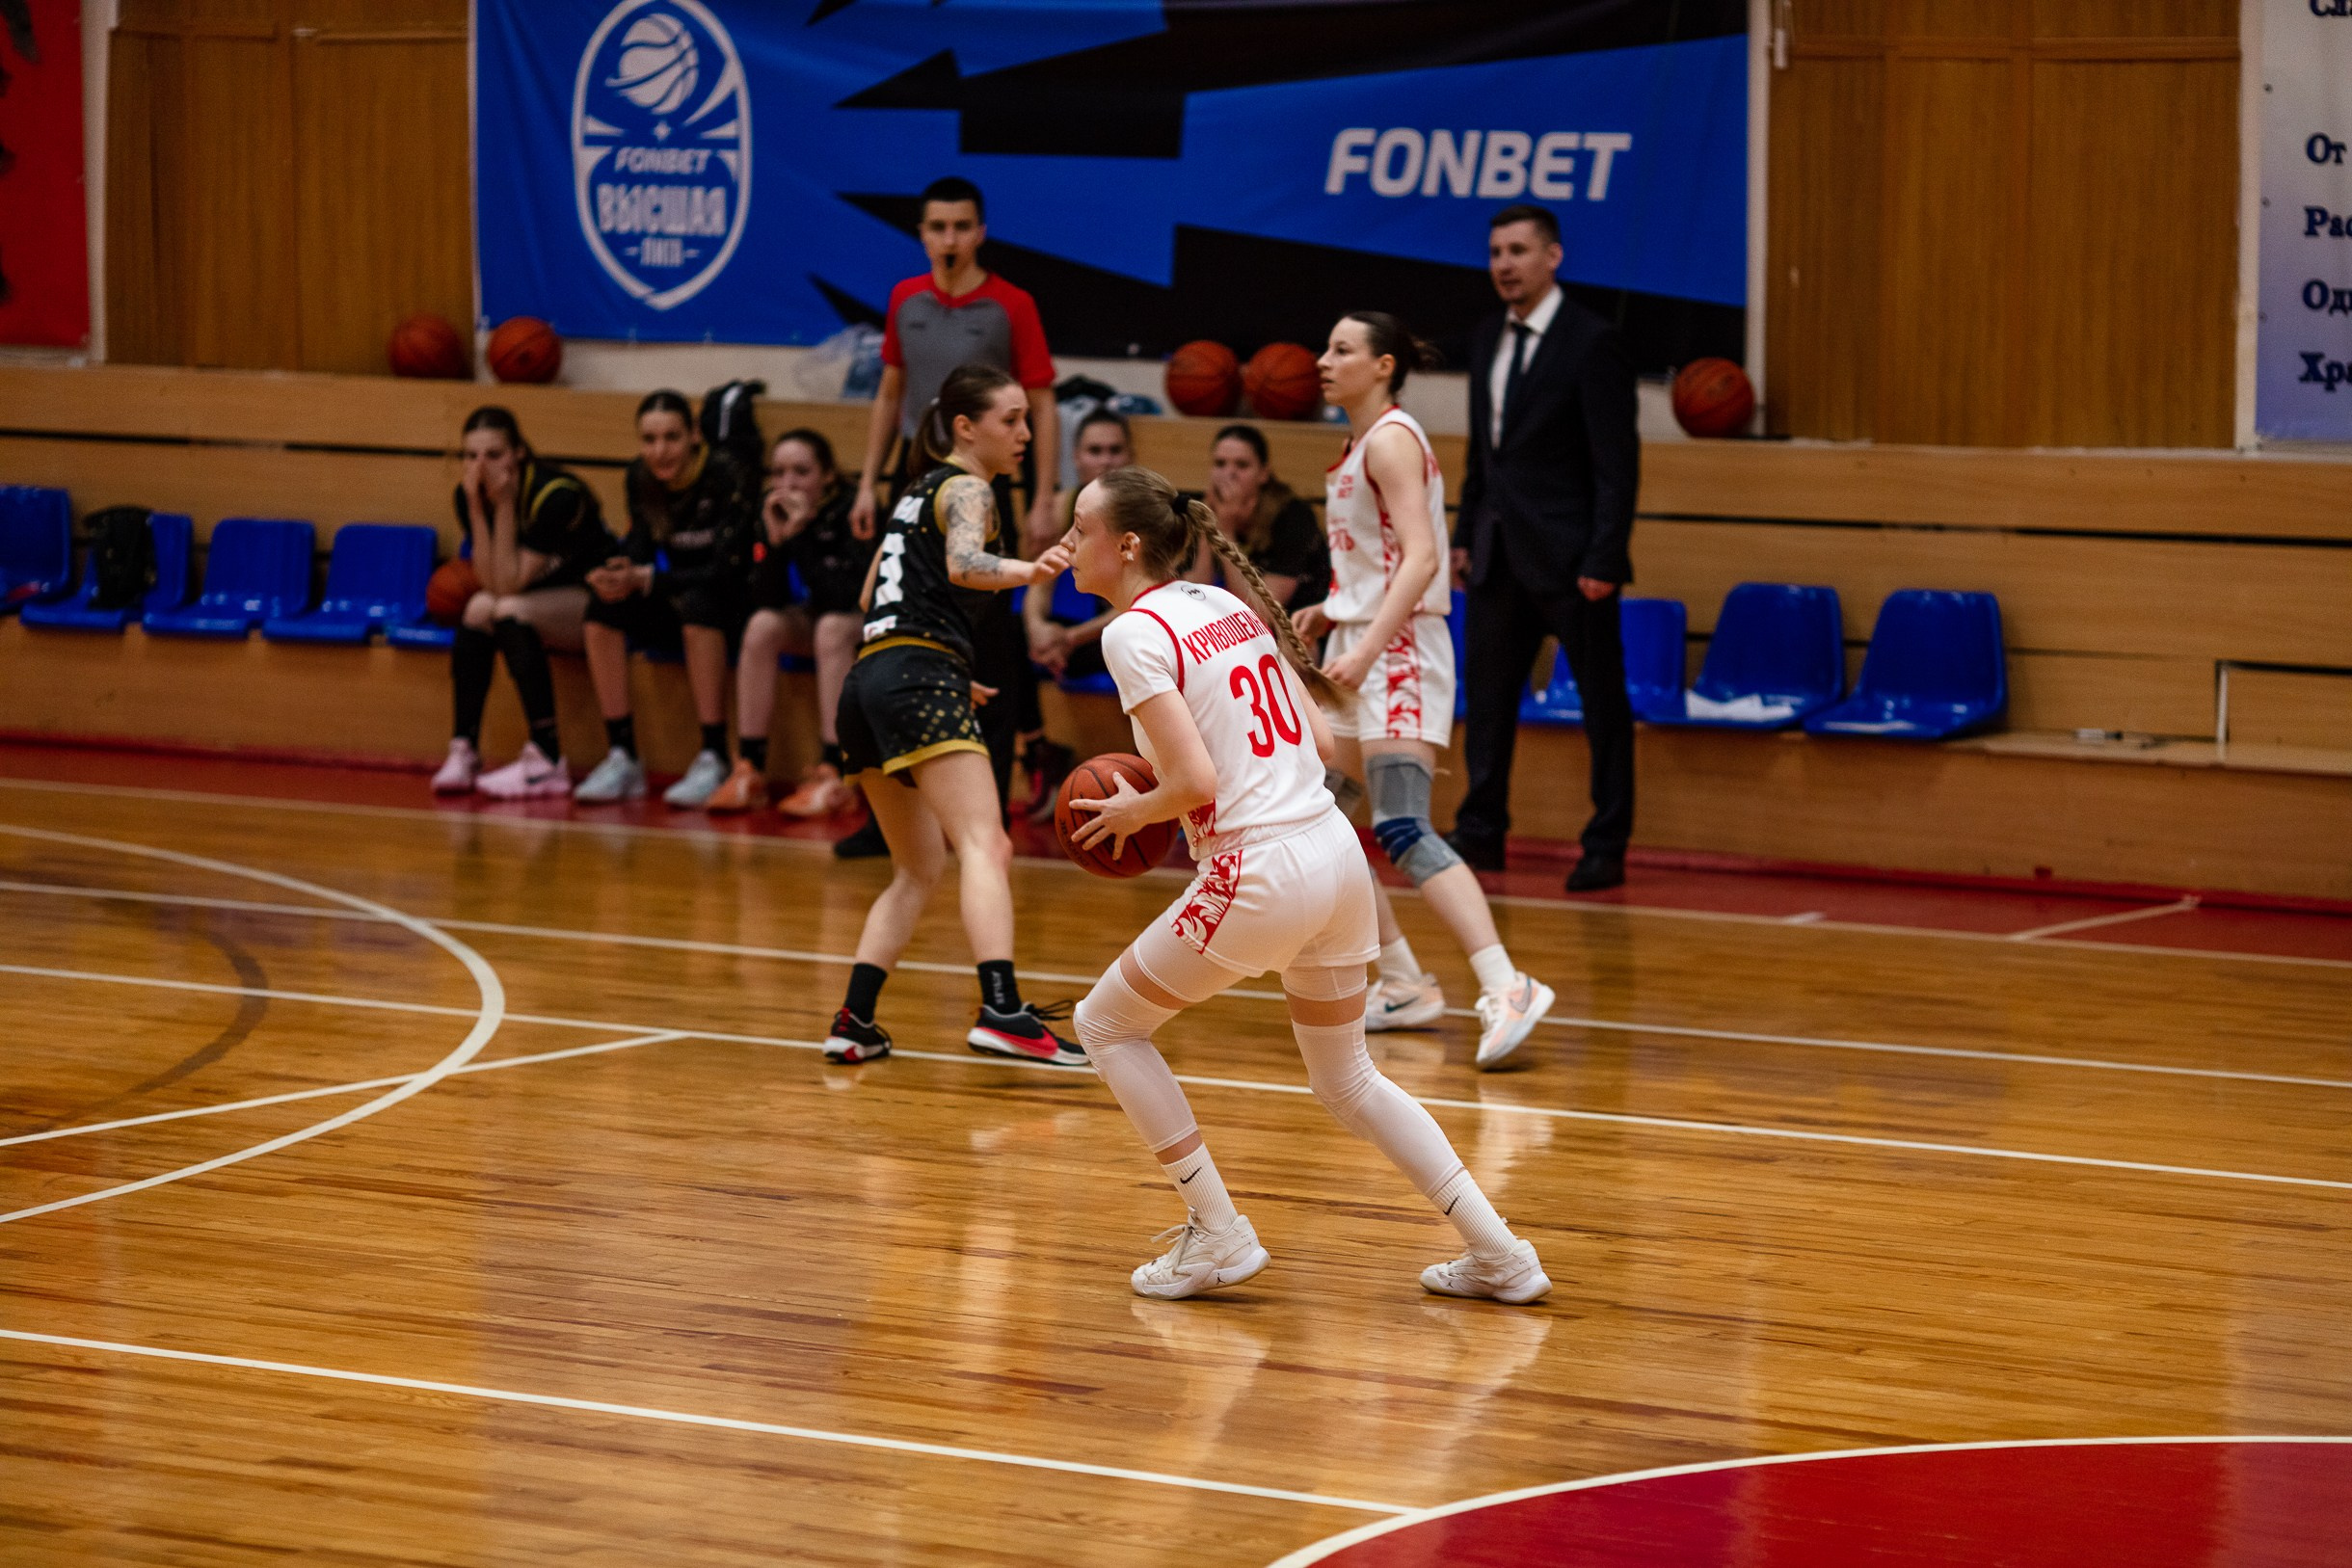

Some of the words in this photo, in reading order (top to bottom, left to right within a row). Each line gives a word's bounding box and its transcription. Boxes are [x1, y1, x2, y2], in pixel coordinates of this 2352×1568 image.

[1324, 127, 1632, 201] FONBET
[2307, 132, 2347, 164] От
[1229, 653, 1302, 758] 30
